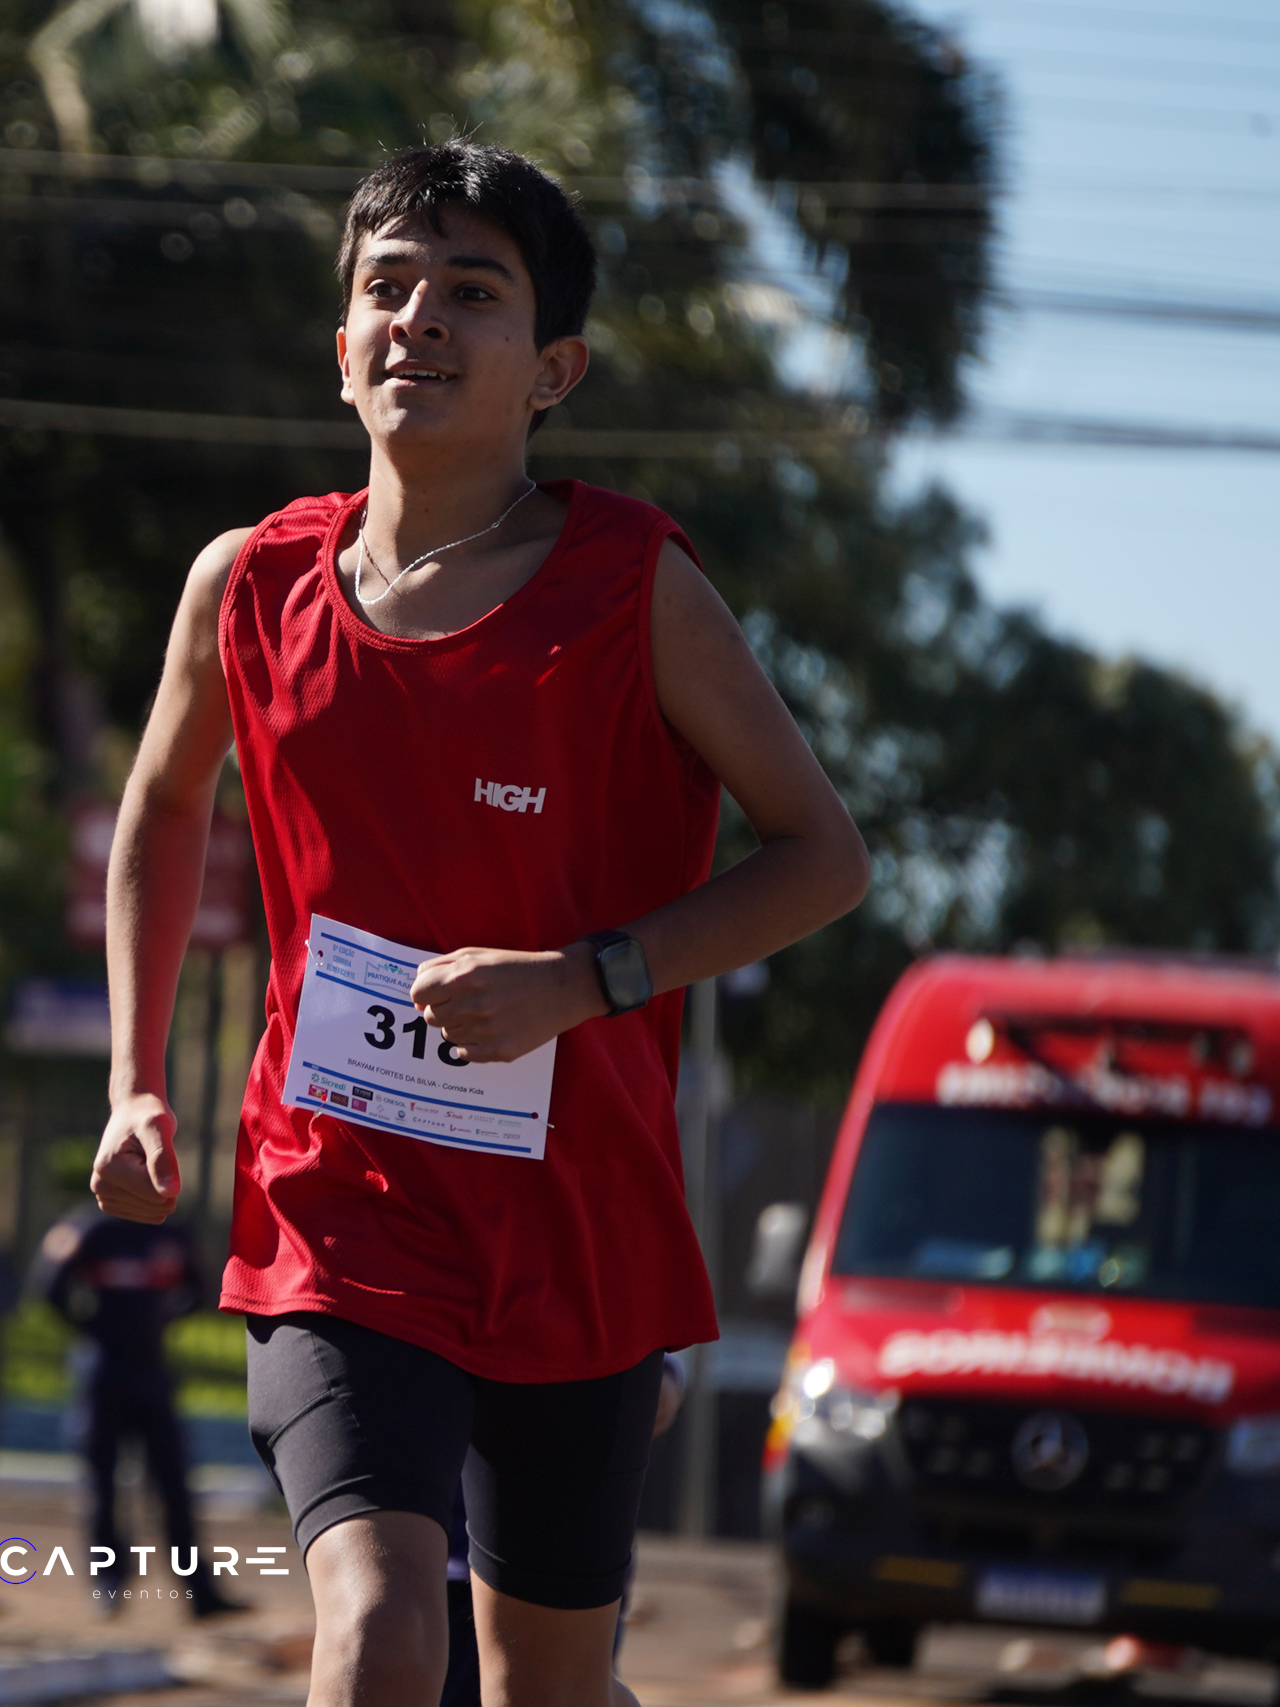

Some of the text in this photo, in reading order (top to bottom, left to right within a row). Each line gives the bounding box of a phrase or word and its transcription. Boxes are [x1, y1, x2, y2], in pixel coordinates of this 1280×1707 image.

[474, 777, 547, 814] HIGH
[333, 954, 351, 968] CORRIDA
[326, 963, 356, 980] BENEFICENTE
[367, 971, 413, 990] PRATIQUE AJU
[320, 1076, 346, 1091] Sicredi
[347, 1057, 375, 1072] BRAYAM
[376, 1066, 404, 1080] FORTES
[405, 1074, 416, 1083] DA
[416, 1077, 437, 1088] SILVA
[442, 1082, 468, 1093] Corrida
[469, 1087, 484, 1096] Kids
[383, 1097, 407, 1108] CRESOL
[412, 1116, 445, 1128] CAPTURE
